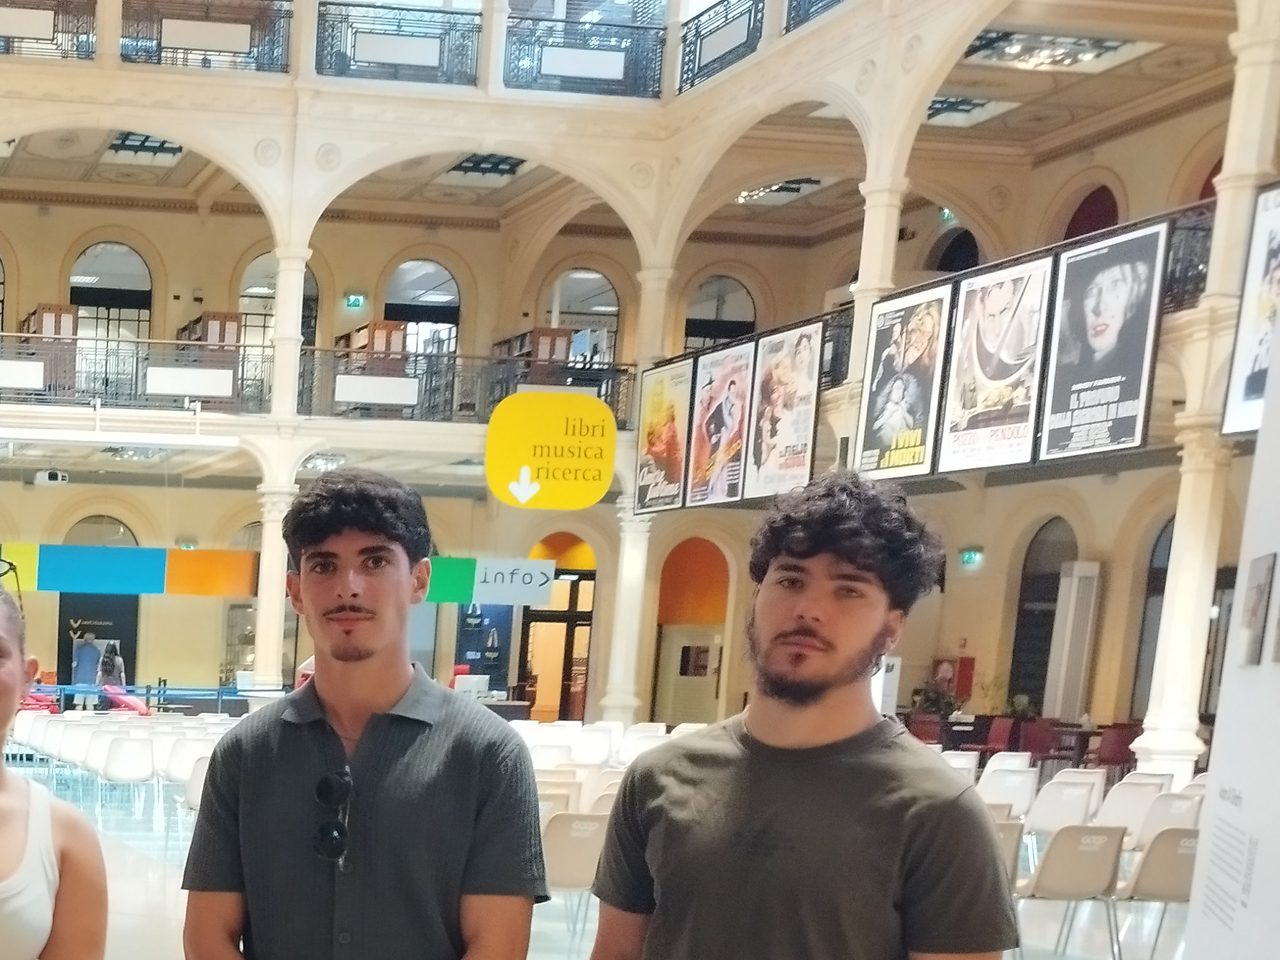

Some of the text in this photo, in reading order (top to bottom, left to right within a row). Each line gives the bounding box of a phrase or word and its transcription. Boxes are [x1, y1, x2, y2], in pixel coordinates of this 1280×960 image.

[564, 417, 606, 437] libri
[532, 440, 604, 459] musica
[535, 461, 602, 481] ricerca
